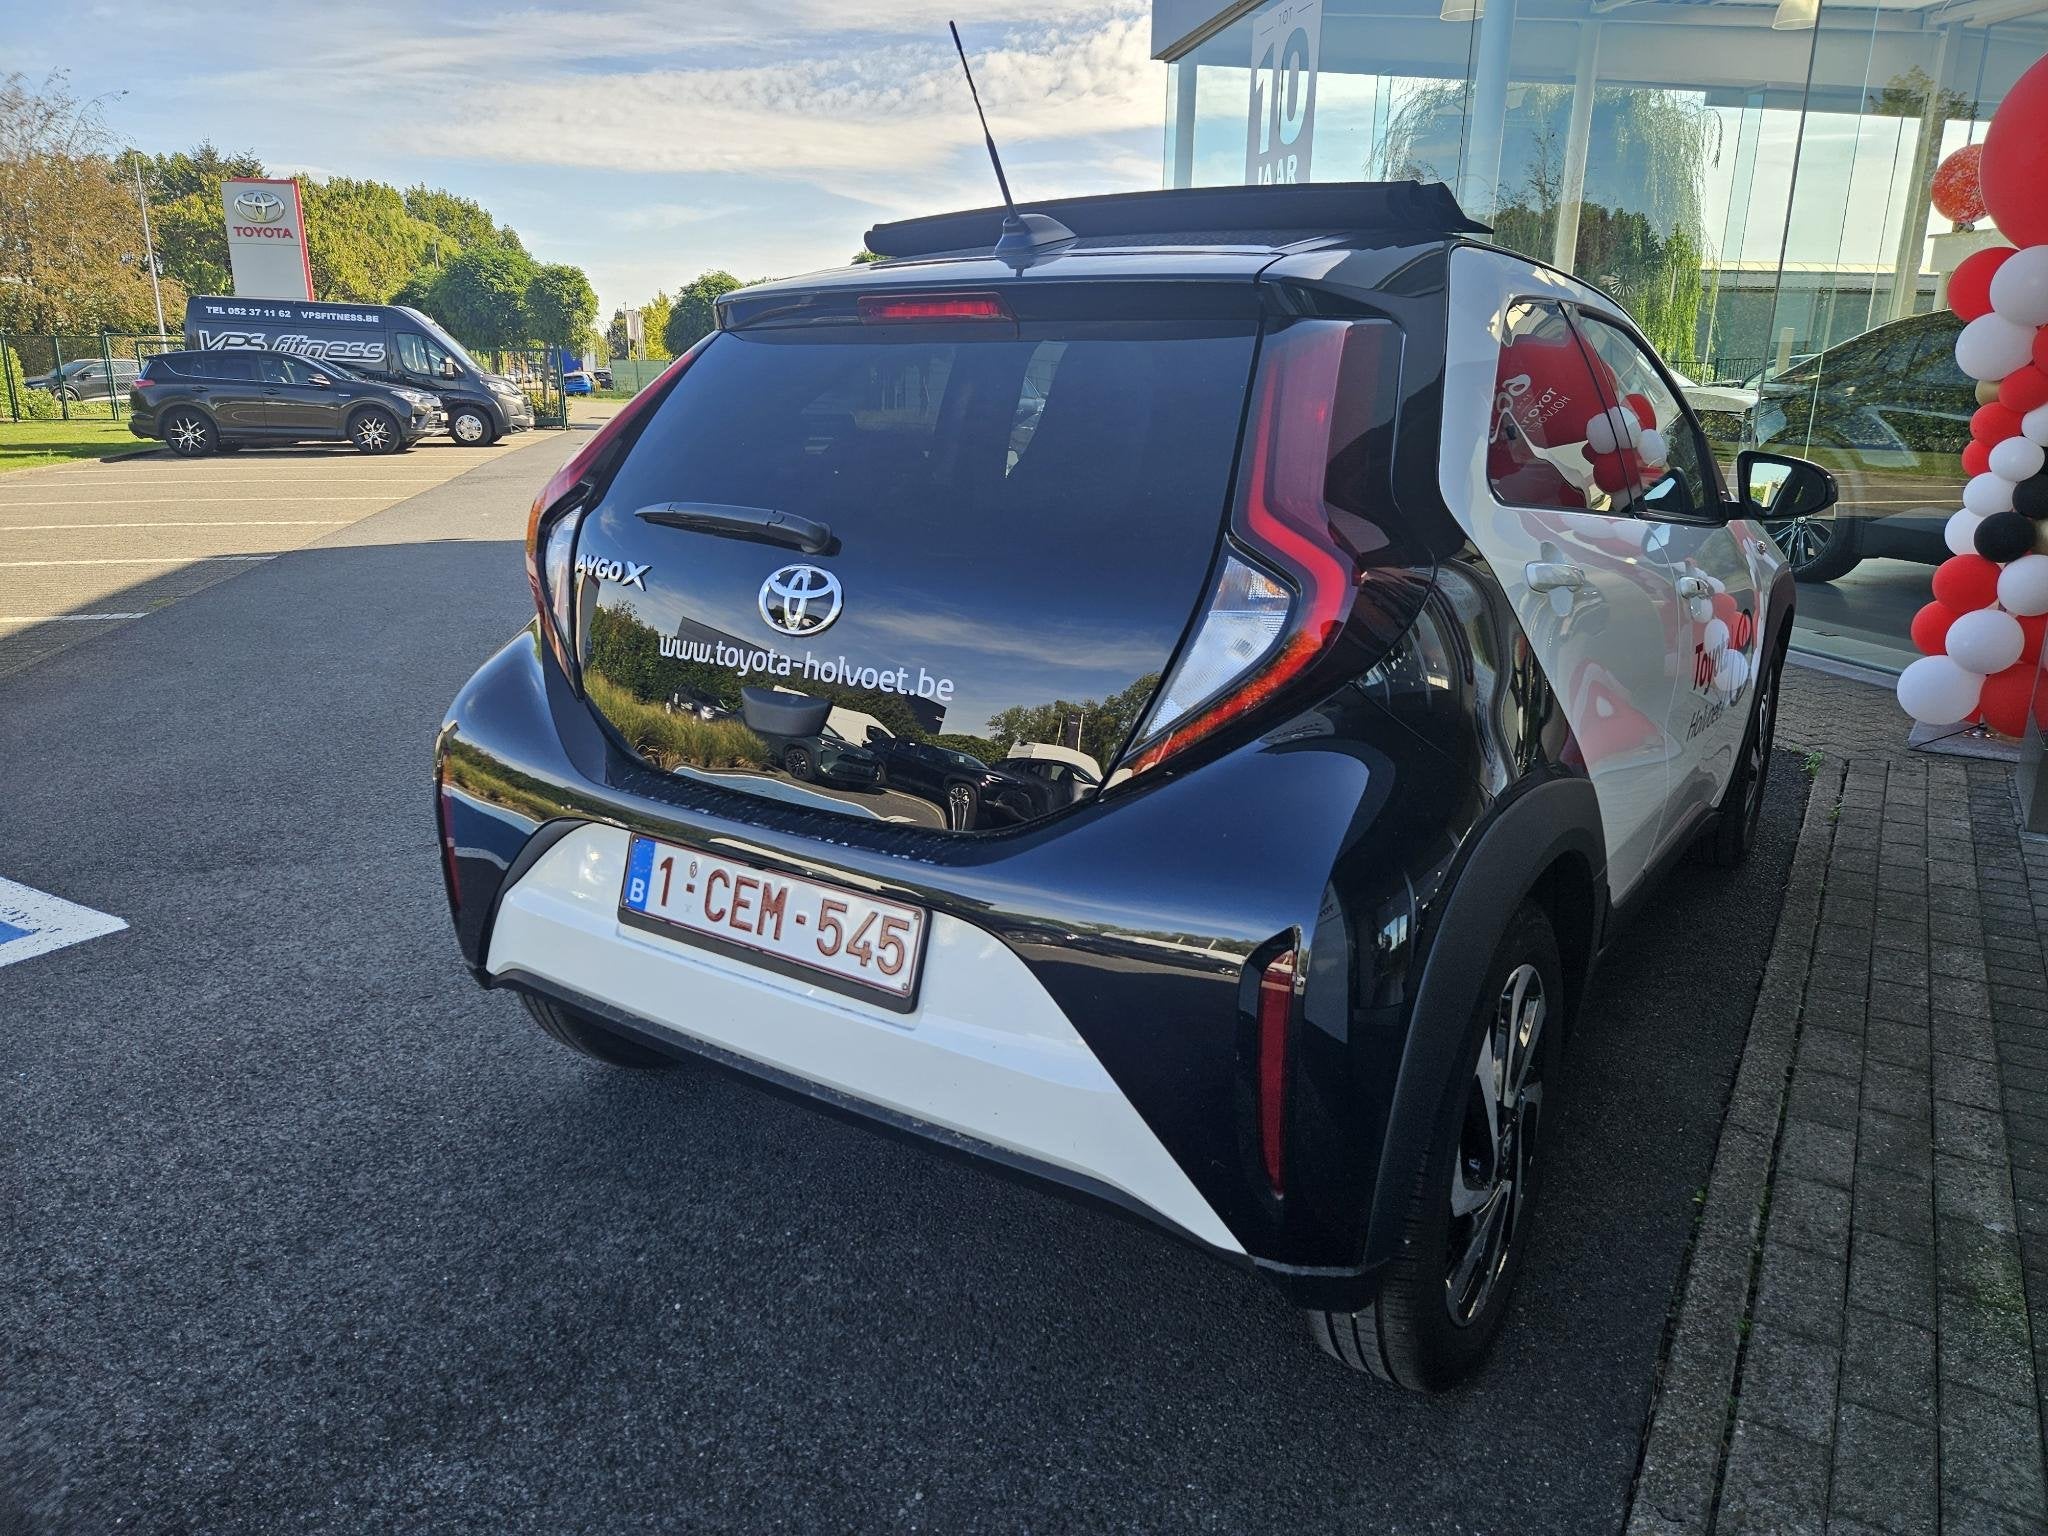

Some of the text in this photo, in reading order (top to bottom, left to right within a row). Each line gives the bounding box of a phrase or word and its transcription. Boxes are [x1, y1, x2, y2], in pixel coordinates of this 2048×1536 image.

[1278, 7, 1293, 27] TOT
[1256, 27, 1310, 155] 10
[1257, 154, 1298, 186] JAAR
[233, 226, 294, 239] TOYOTA
[205, 305, 379, 323] TEL 052 37 11 62 VPSFITNESS.BE
[199, 329, 268, 351] VPS
[575, 553, 653, 592] AYGO X
[658, 635, 956, 702] www.toyota-holvoet.be
[628, 877, 646, 903] B
[659, 856, 911, 976] 1-CEM-545
